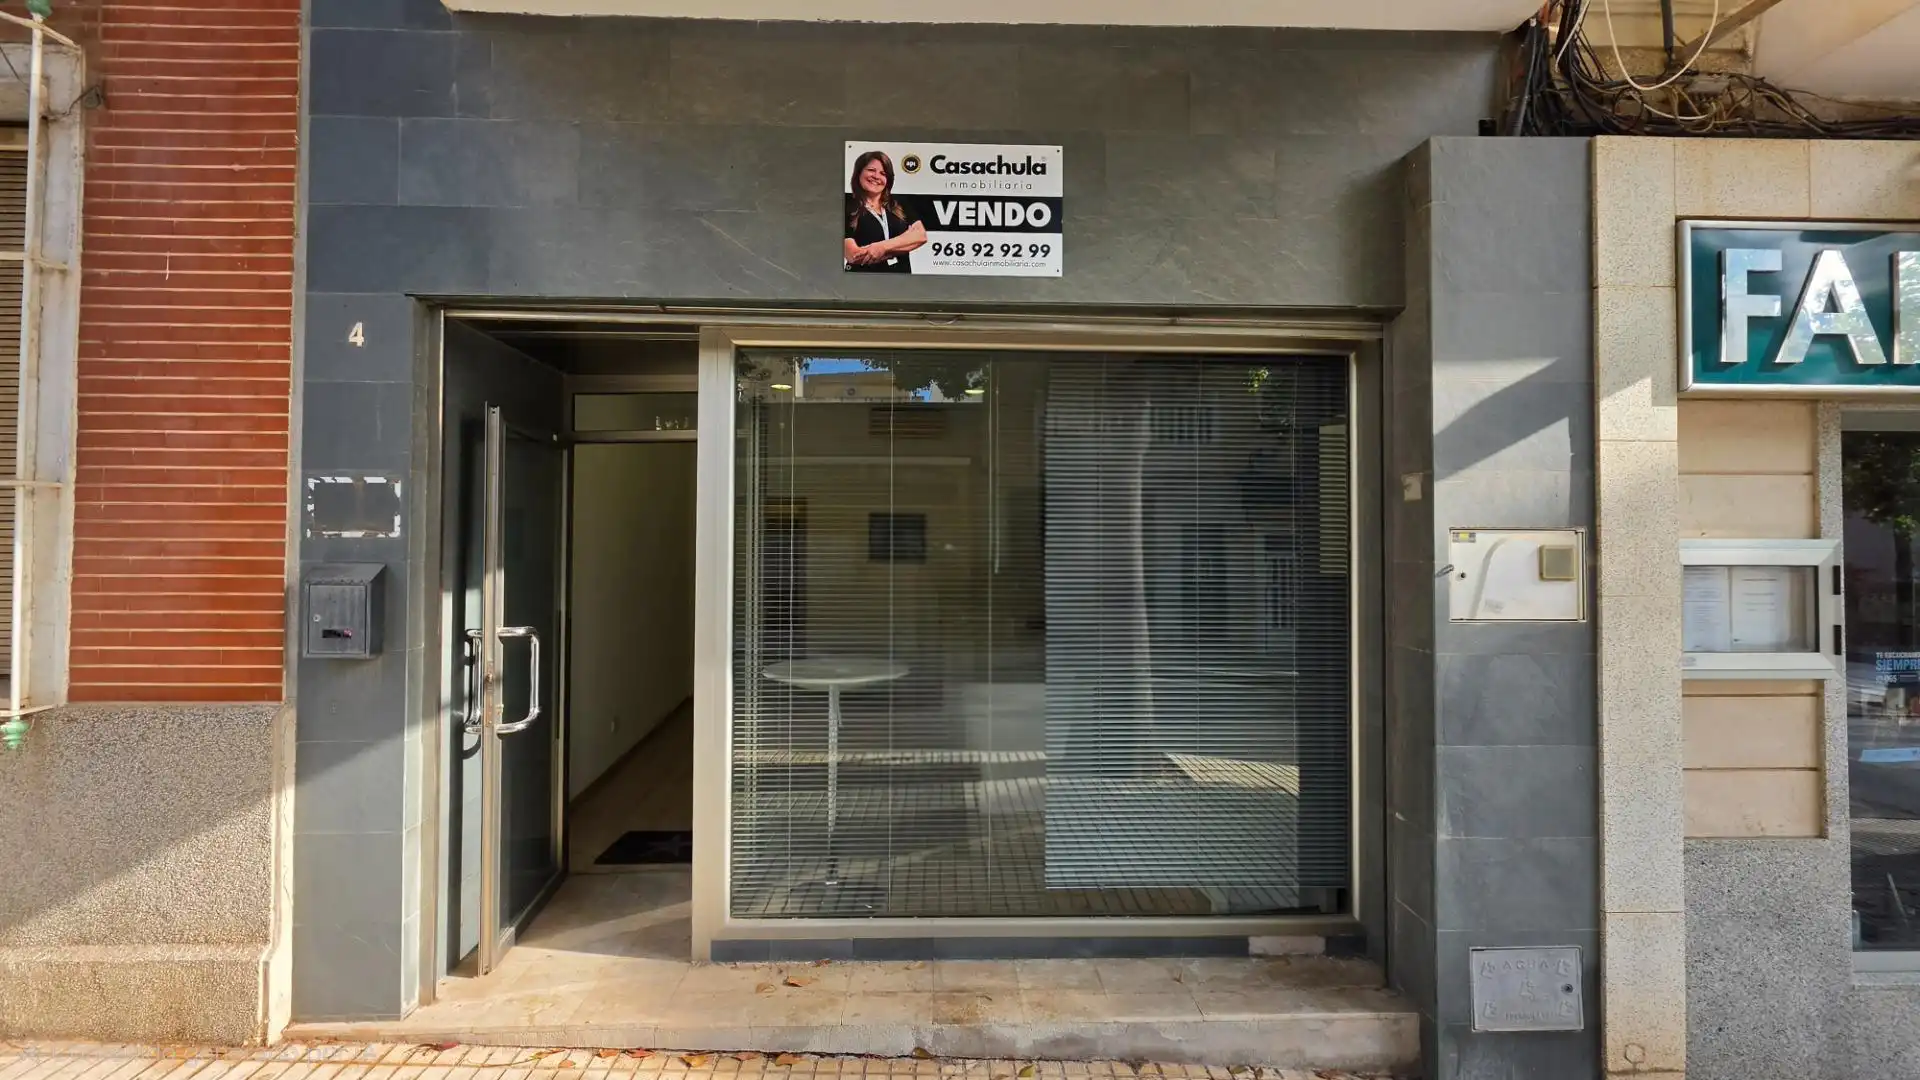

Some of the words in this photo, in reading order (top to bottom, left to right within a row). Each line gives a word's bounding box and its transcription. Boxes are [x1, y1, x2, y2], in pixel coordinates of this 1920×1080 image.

[930, 154, 1047, 176] Casachula
[945, 179, 1033, 190] inmobiliaria
[932, 200, 1052, 228] VENDO
[931, 242, 966, 257] 968
[971, 242, 995, 258] 92
[1000, 243, 1023, 258] 92
[1028, 243, 1051, 258] 99
[932, 259, 1047, 268] www.casachulainmobiliaria.com
[348, 321, 365, 347] 4
